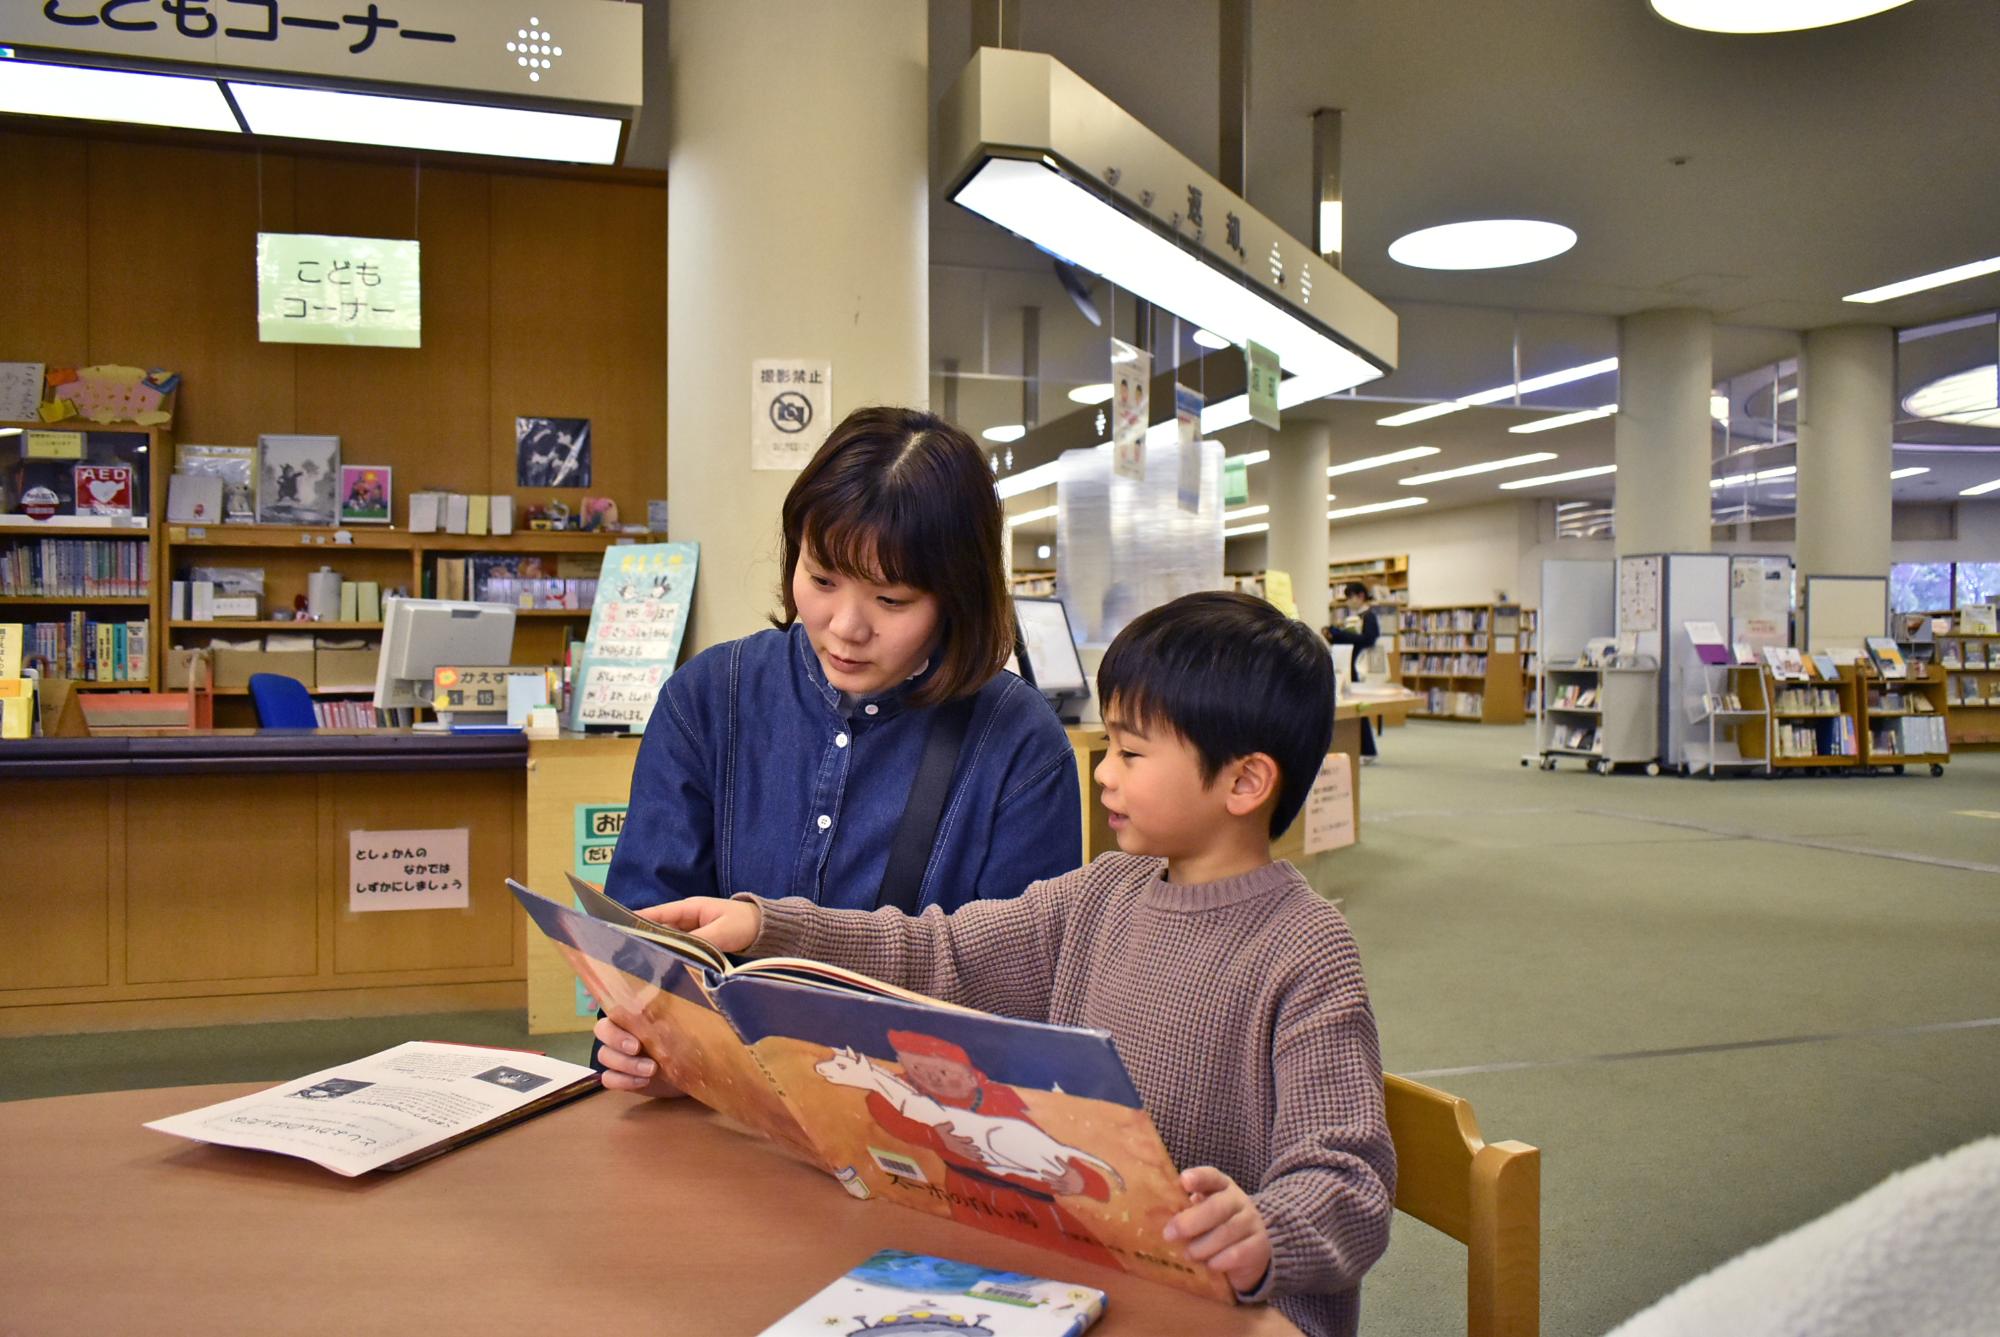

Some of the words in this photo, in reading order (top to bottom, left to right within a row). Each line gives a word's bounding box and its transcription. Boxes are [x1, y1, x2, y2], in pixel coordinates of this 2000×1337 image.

[298, 260, 382, 287] こども
[284, 297, 396, 322] コーナー
[761, 369, 824, 385] 撮影禁止
[81, 468, 127, 480] AED
[356, 847, 428, 860] としょかんの
[404, 863, 450, 875] なかでは
[356, 879, 462, 894] しずかにしましょう
